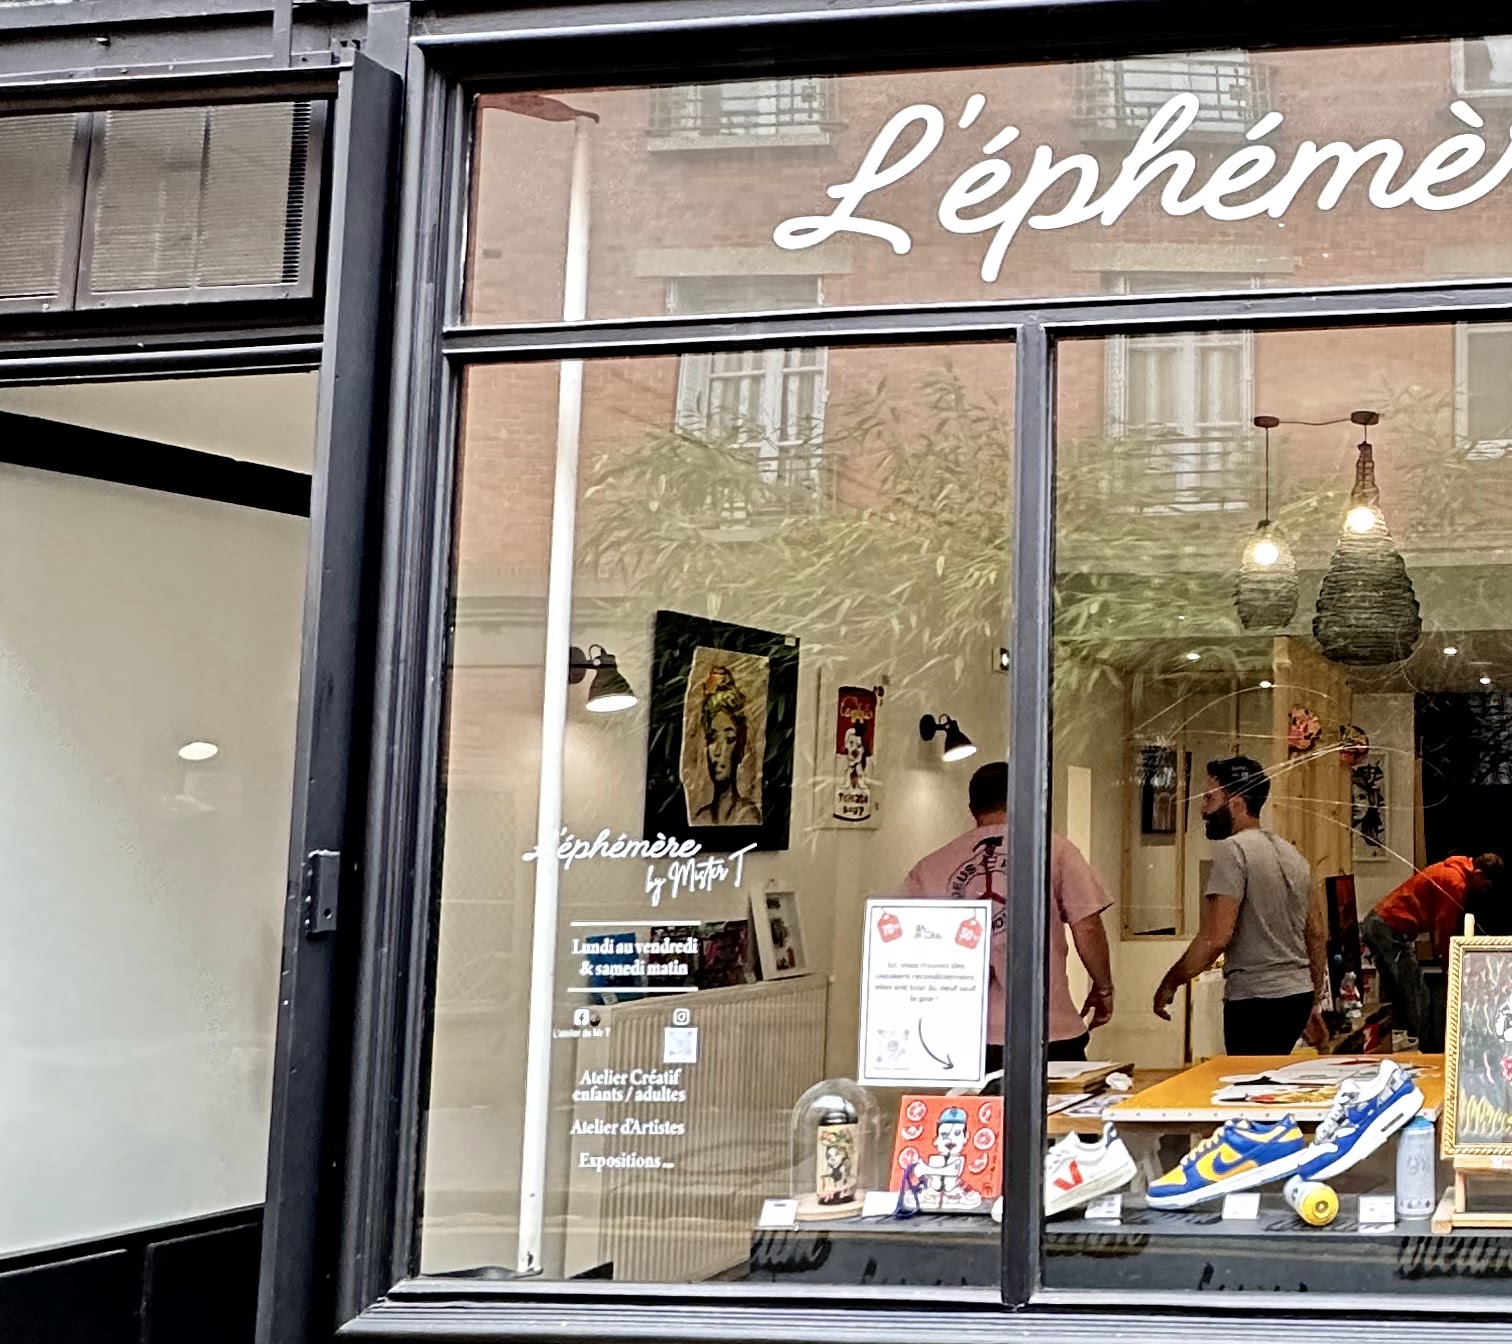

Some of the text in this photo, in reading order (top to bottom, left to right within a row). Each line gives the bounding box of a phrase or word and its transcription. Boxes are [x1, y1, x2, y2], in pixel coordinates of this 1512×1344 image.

[645, 843, 758, 906] by Mister T
[571, 937, 699, 955] Lundi au vendredi
[579, 959, 689, 976] & samedi matin
[579, 1068, 682, 1085] Atelier Créatif
[572, 1085, 624, 1102] enfants
[635, 1085, 687, 1102] adultes
[570, 1117, 685, 1135] Atelier d'Artistes
